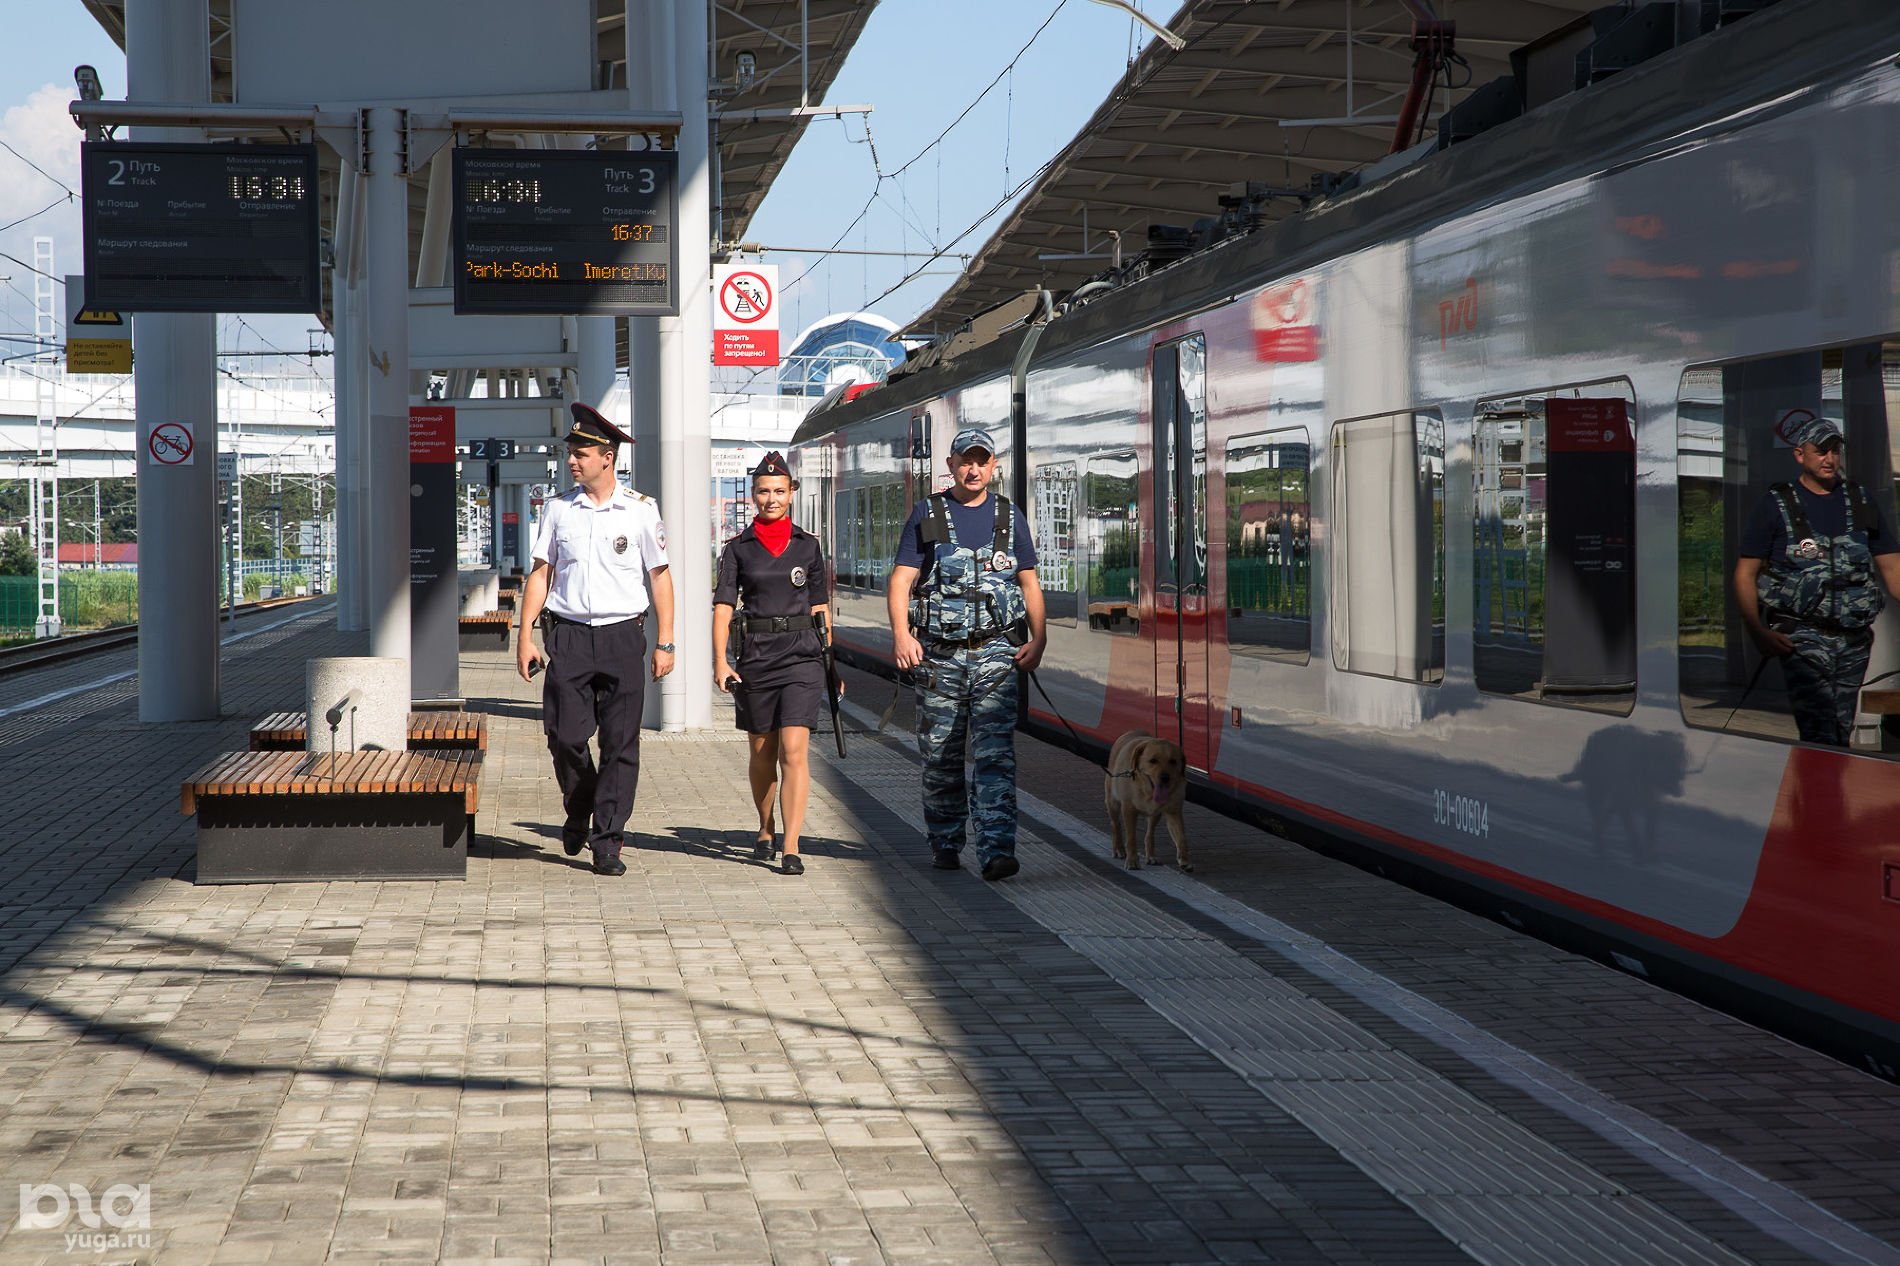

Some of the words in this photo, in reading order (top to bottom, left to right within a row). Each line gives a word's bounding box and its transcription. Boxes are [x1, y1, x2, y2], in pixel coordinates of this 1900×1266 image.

[108, 160, 125, 185] 2
[129, 161, 160, 175] Путь
[131, 177, 157, 186] Track
[604, 168, 634, 181] Путь
[638, 168, 655, 193] 3
[605, 183, 630, 193] Track
[239, 201, 297, 211] Отправление
[602, 207, 657, 216] Отправление
[611, 224, 653, 241] 16:37
[98, 239, 138, 249] Маршрут
[139, 240, 188, 249] следования
[723, 333, 750, 342] Ходить
[733, 343, 755, 351] путям
[723, 350, 766, 359] запрещено!
[475, 443, 485, 456] 2
[500, 443, 509, 456] 3
